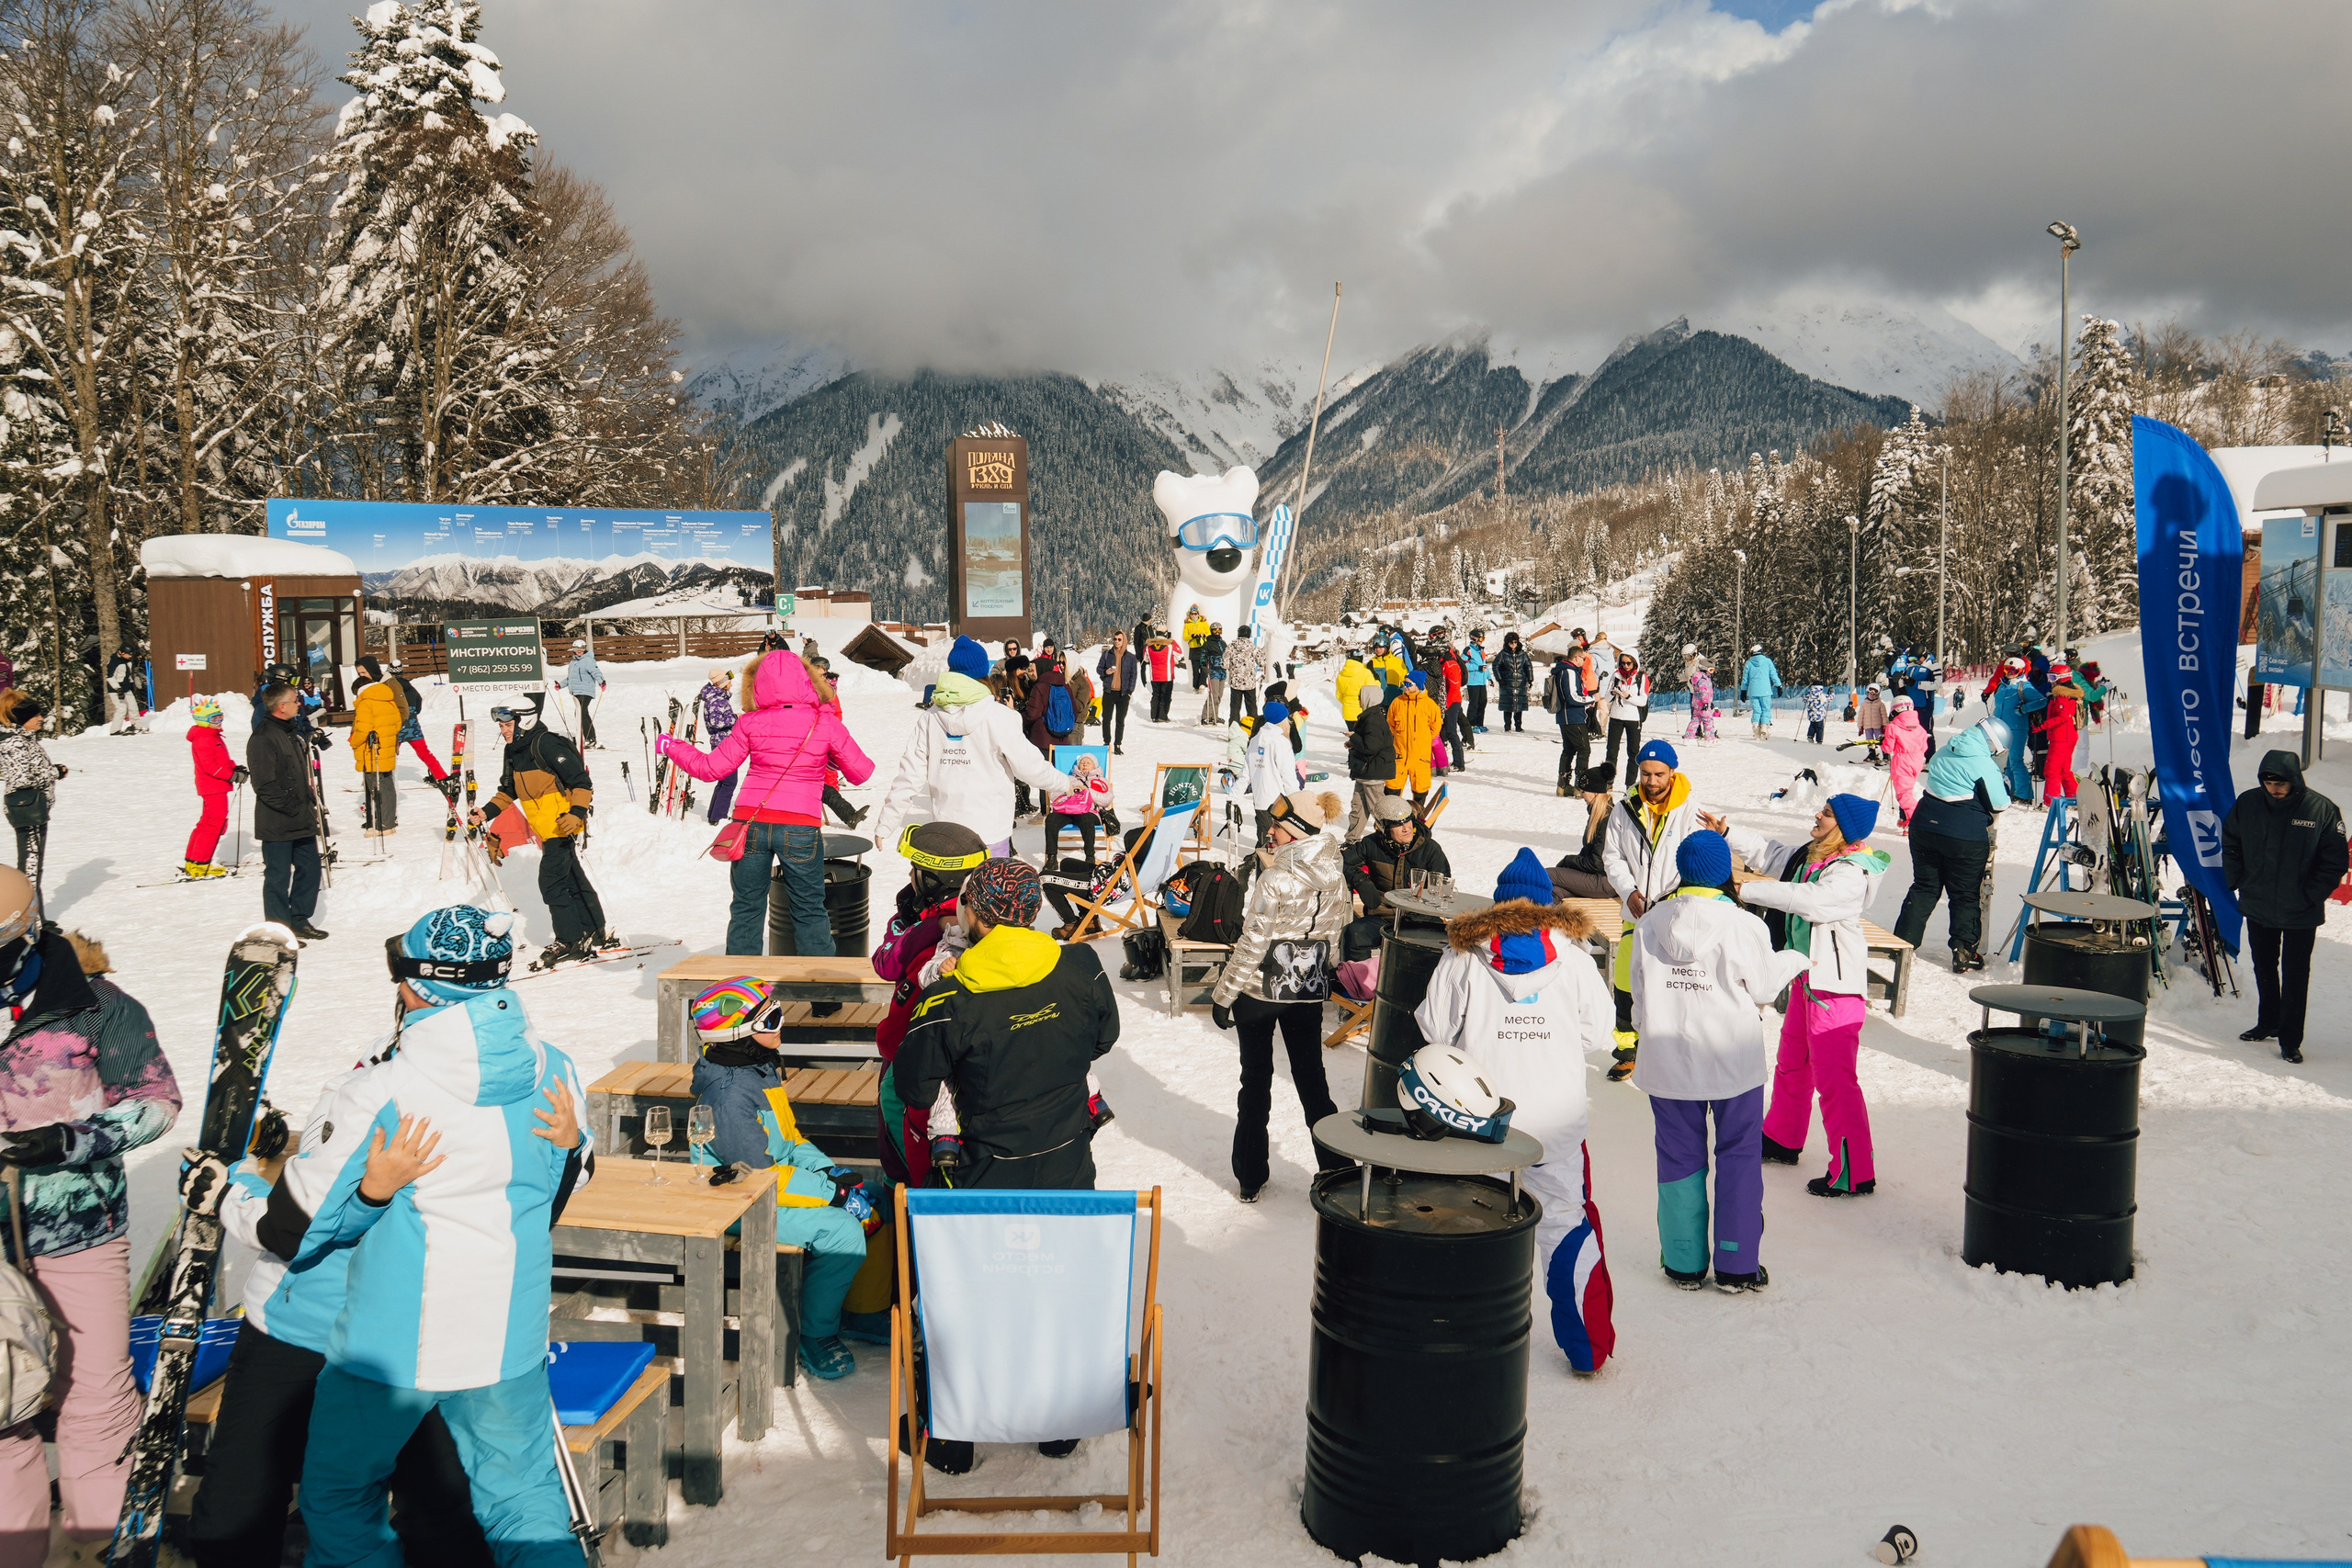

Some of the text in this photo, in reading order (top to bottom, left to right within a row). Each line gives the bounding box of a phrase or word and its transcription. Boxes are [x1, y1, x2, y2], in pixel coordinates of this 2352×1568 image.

[968, 451, 1016, 468] ПОЛЯНА
[968, 463, 1015, 484] 1389
[1259, 588, 1270, 600] VK
[260, 584, 277, 670] ОСЛУЖБА
[450, 646, 536, 657] ИНСТРУКТОРЫ
[2178, 530, 2207, 794] место встречи
[469, 665, 490, 675] (862)
[492, 665, 508, 673] 259
[522, 664, 532, 672] 99
[1169, 782, 1198, 796] HUNTING
[1287, 816, 1306, 831] ALPINA
[2198, 822, 2220, 858] VK
[911, 852, 964, 868] SALICE
[1672, 968, 1706, 977] место
[1666, 981, 1713, 991] встречи
[1504, 1016, 1545, 1024] место
[1498, 1031, 1551, 1042] встречи
[1414, 1086, 1488, 1132] OAKLEY
